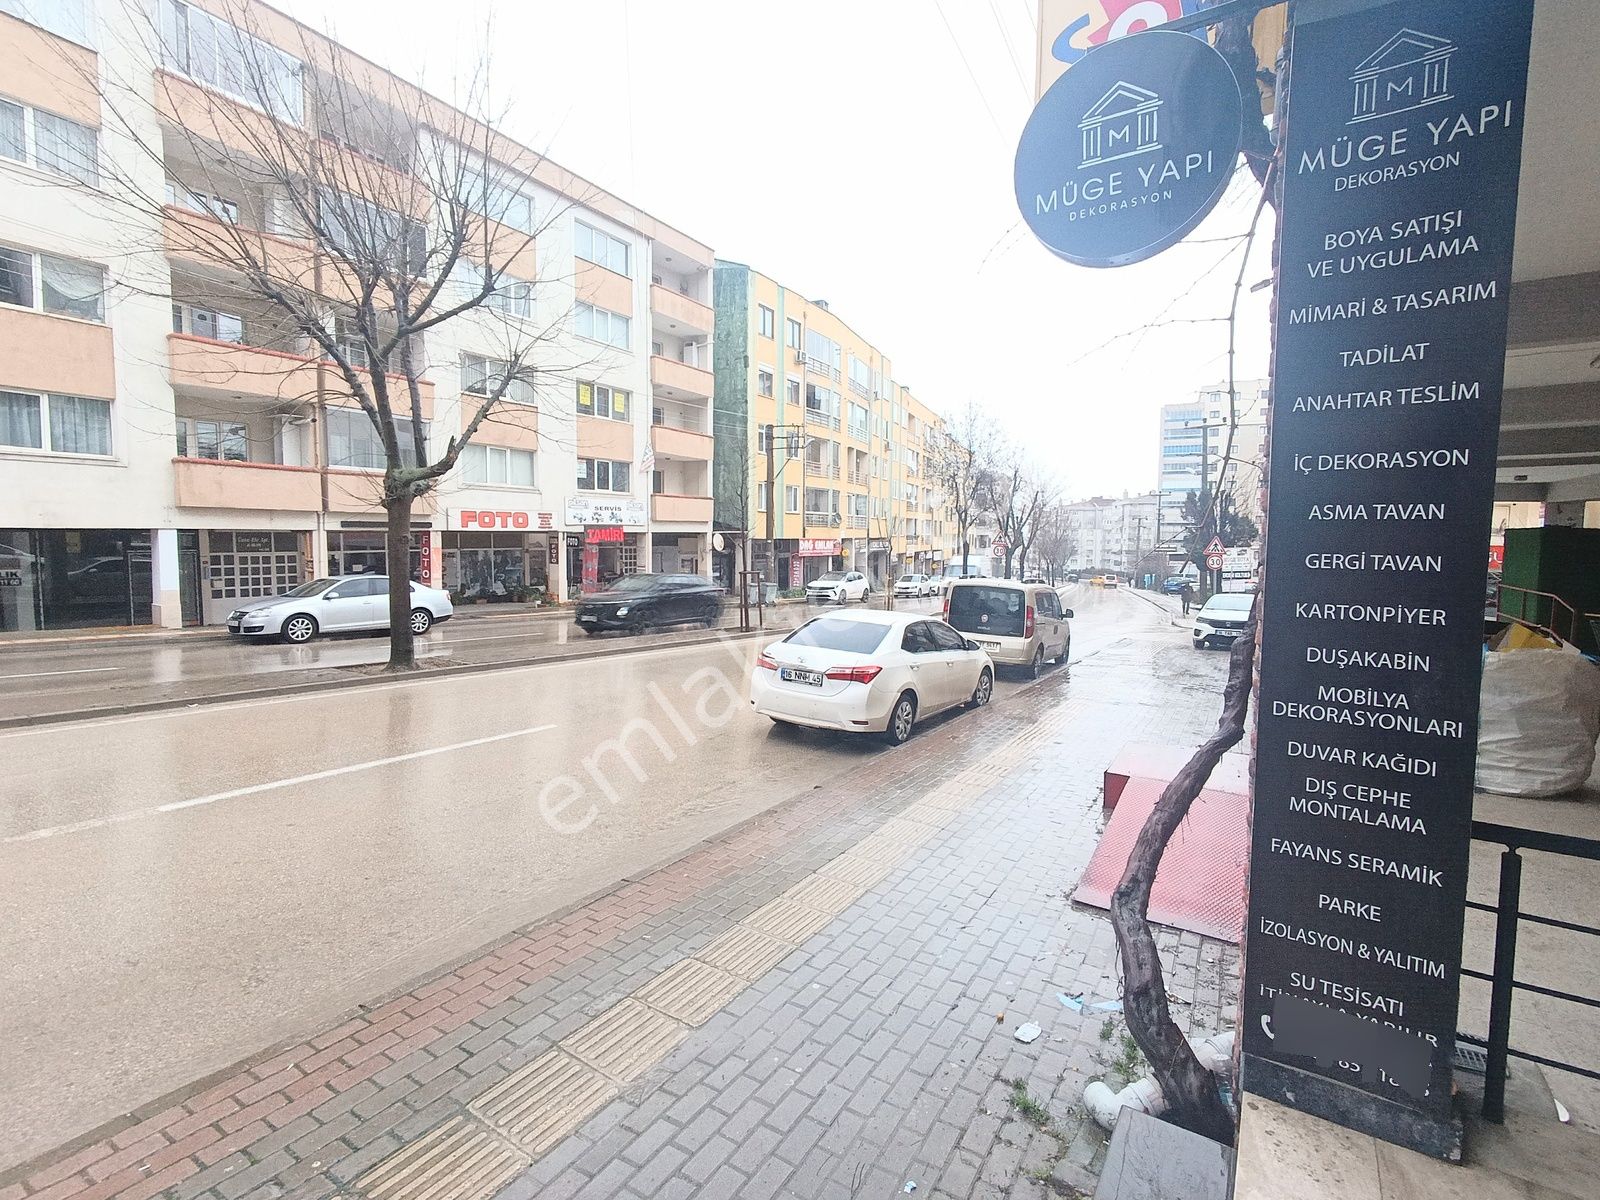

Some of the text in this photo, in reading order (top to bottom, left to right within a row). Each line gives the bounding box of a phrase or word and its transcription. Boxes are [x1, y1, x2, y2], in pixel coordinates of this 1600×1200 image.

[1386, 77, 1413, 102] M
[1109, 128, 1130, 145] M
[1298, 99, 1513, 176] MÜGE YAPI
[1036, 149, 1214, 216] MÜGE YAPI
[1333, 151, 1461, 192] DEKORASYON
[1068, 188, 1173, 221] DEKORASYON
[1323, 210, 1463, 251] BOYA SATIŞI
[1307, 236, 1479, 279] VE UYGULAMA
[1289, 280, 1498, 325] MİMARİ & TASARIM
[1340, 342, 1430, 368] TADİLAT
[1292, 381, 1480, 412] ANAHTAR TESLİM
[1294, 448, 1470, 476] İÇ DEKORASYON
[460, 511, 529, 529] FOTO
[1308, 503, 1445, 520] ASMA TAVAN
[422, 535, 430, 578] FOTO
[1210, 558, 1221, 566] 30
[1304, 552, 1442, 572] GERGİ TAVAN
[1296, 602, 1446, 626] KARTONPİYER
[1306, 647, 1430, 672] DUŞAKABİN
[785, 670, 792, 679] 16
[812, 674, 821, 683] 45
[1318, 685, 1409, 710] MOBİLYA
[1272, 701, 1463, 738] DEKORASYONLARI
[1287, 741, 1437, 777] DUVAR KAĞIDI
[1305, 777, 1411, 809] DIŞ CEPHE
[1289, 796, 1426, 835] MONTALAMA
[1271, 838, 1443, 887] FAYANS SERAMİK
[1318, 894, 1381, 922] PARKE
[1260, 916, 1445, 979] İZOLASYON & YALITIM
[1290, 972, 1315, 991] SU
[1320, 978, 1404, 1017] TESİSATI
